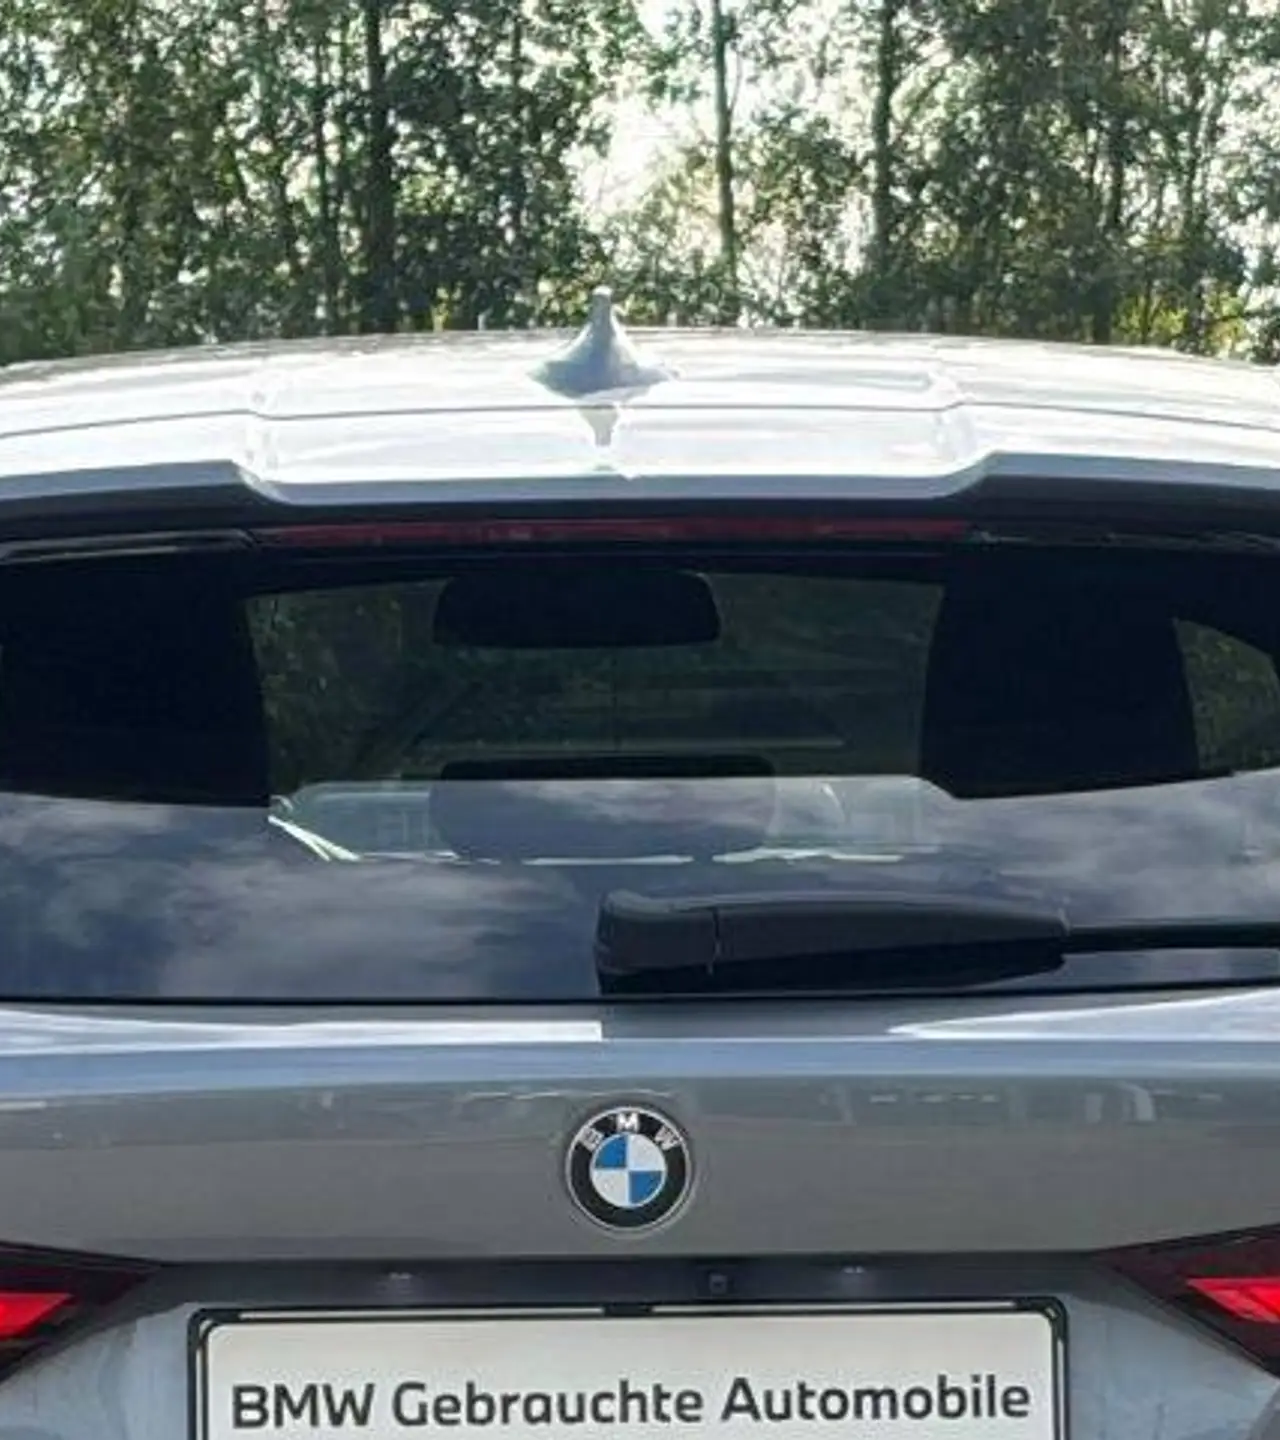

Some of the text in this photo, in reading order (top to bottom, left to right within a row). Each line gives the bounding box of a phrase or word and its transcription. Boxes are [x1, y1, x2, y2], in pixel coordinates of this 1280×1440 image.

[231, 1374, 1031, 1430] BMW Gebrauchte Automobile
